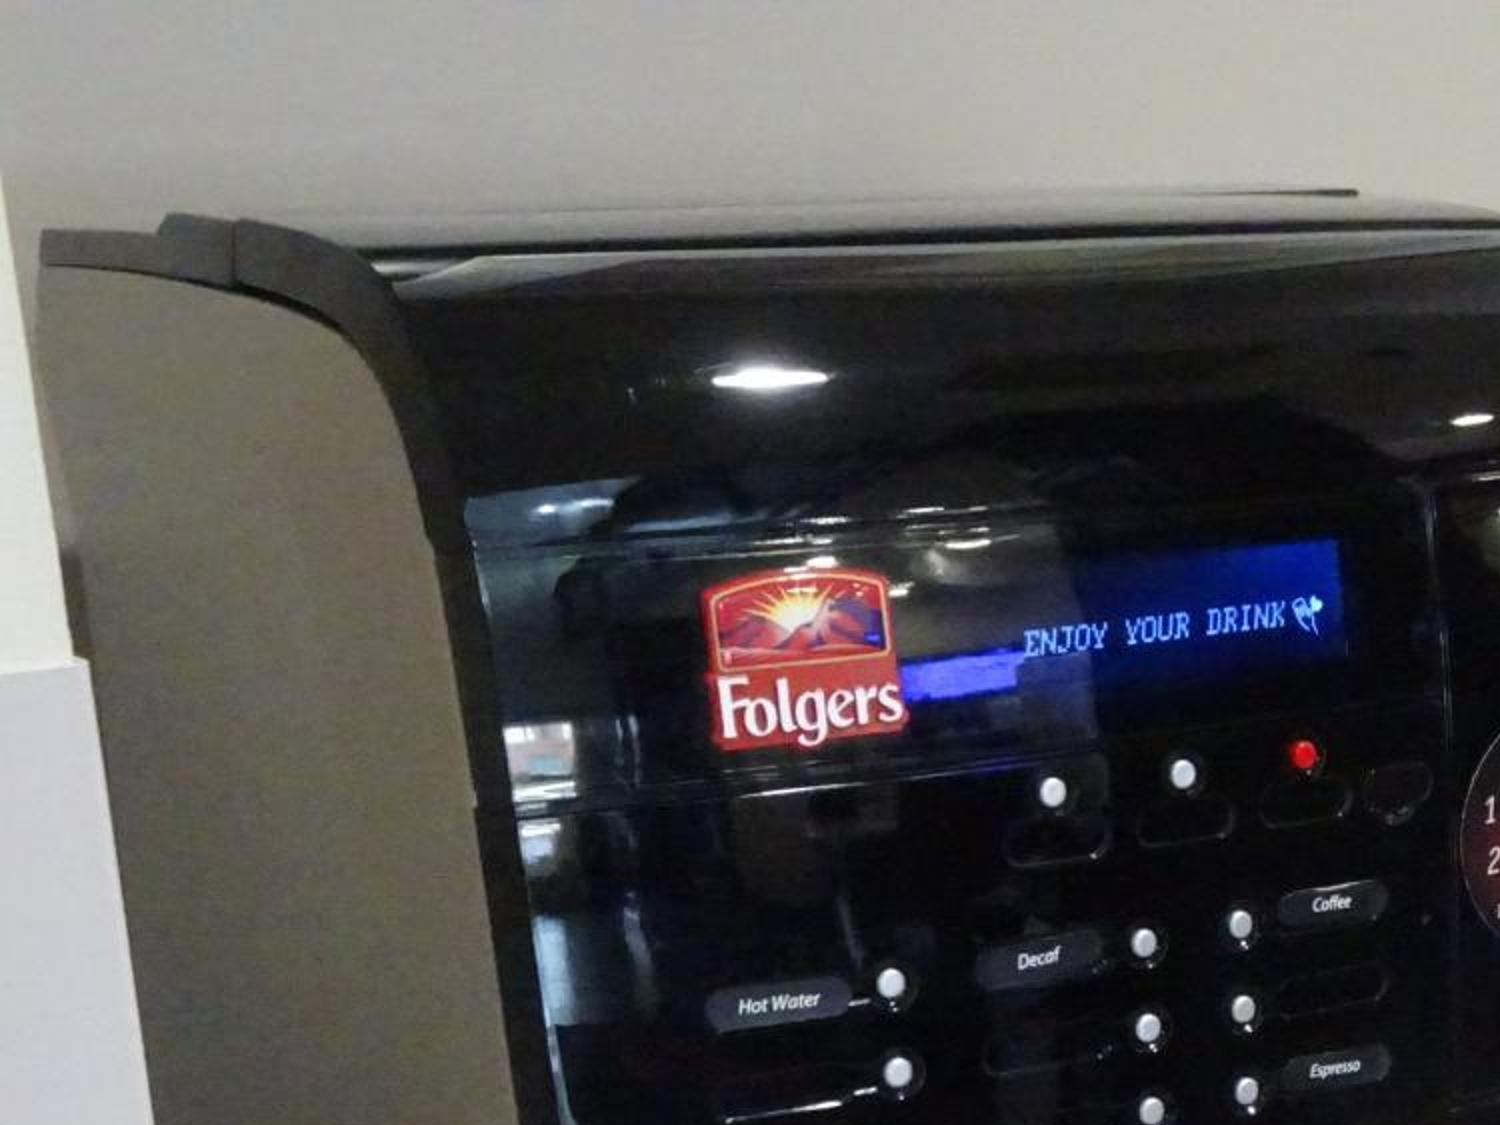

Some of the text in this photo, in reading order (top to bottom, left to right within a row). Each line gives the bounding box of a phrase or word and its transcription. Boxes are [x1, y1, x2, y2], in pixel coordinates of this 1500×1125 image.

[1023, 600, 1287, 657] ENJOY YOUR DRINK
[716, 675, 903, 747] Folgers
[1484, 795, 1496, 825] 1
[1311, 892, 1353, 914] Coffee
[1016, 944, 1061, 970] Decaf
[737, 989, 821, 1016] Hot Water
[1309, 1056, 1362, 1079] Espresso
